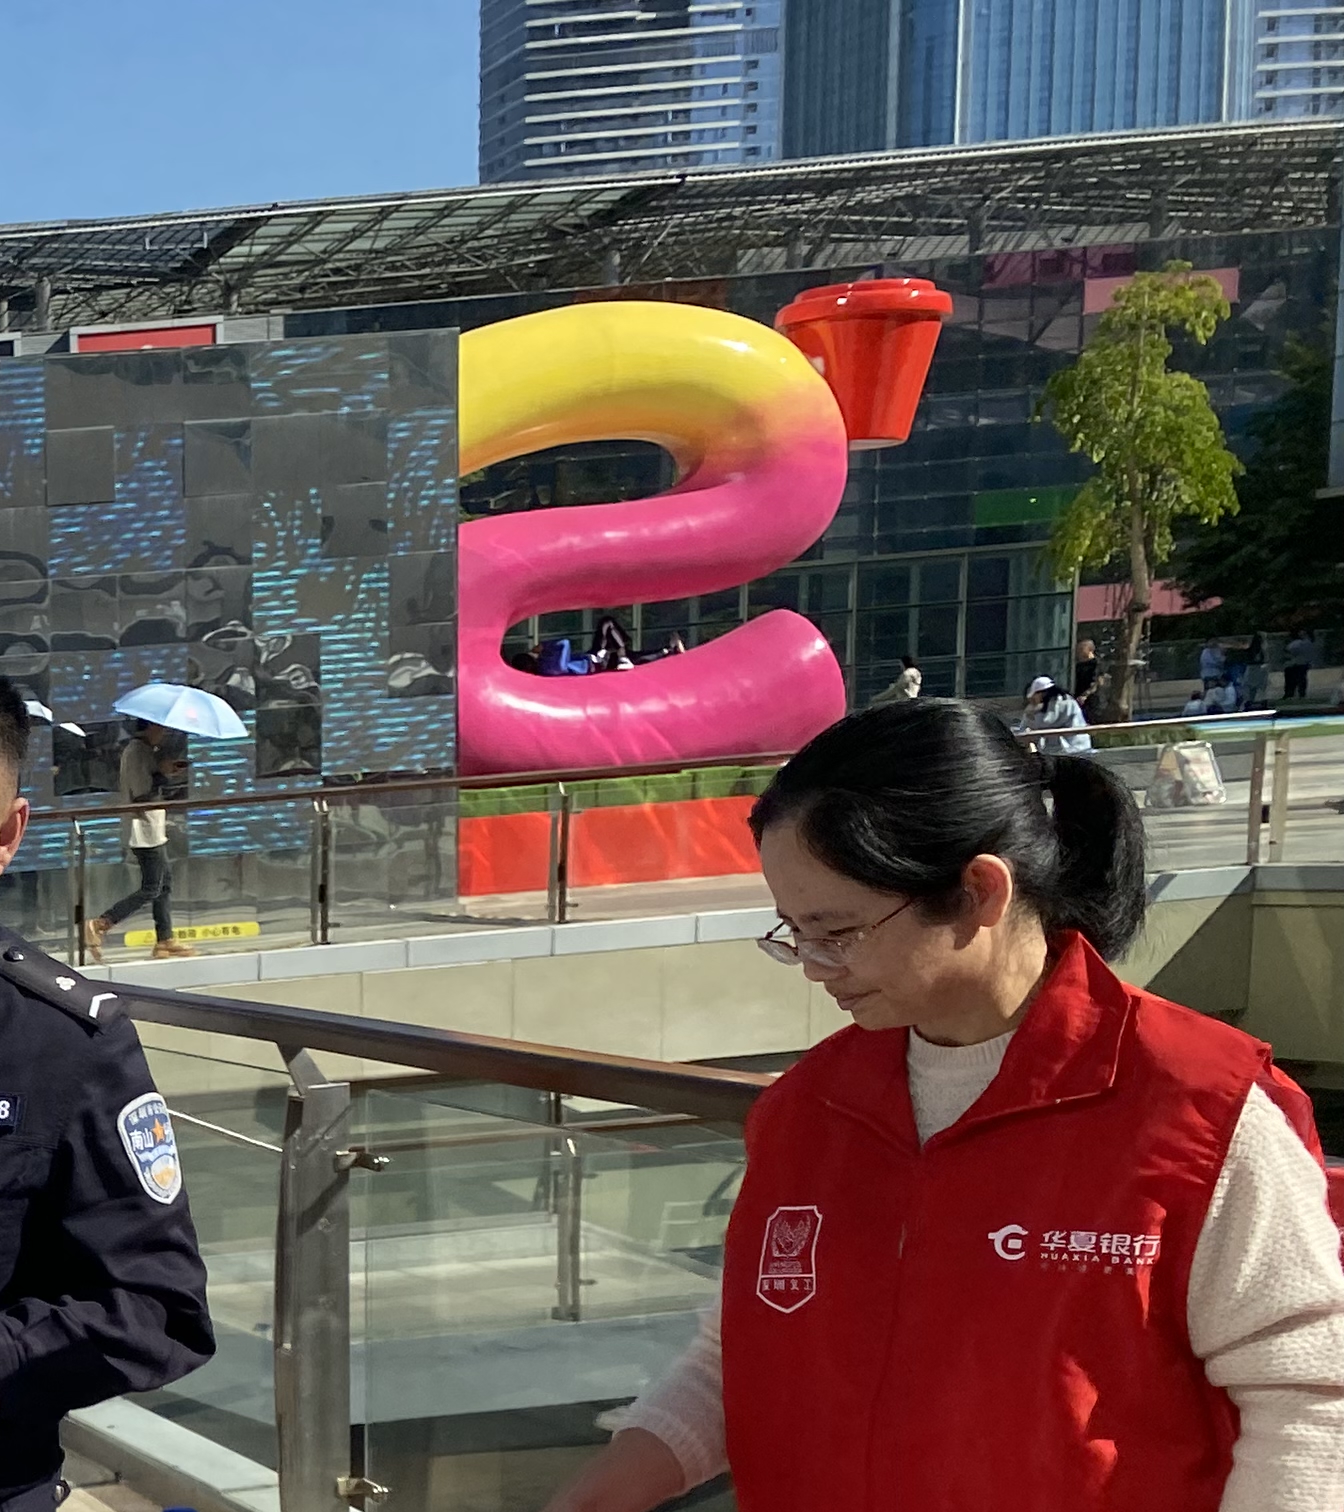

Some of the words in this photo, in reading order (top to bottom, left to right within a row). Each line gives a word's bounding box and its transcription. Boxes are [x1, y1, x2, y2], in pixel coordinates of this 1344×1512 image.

[129, 1127, 154, 1151] 南山
[1040, 1230, 1161, 1257] 华夏银行
[1040, 1252, 1100, 1262] HUAXIA
[1111, 1257, 1155, 1265] BANK
